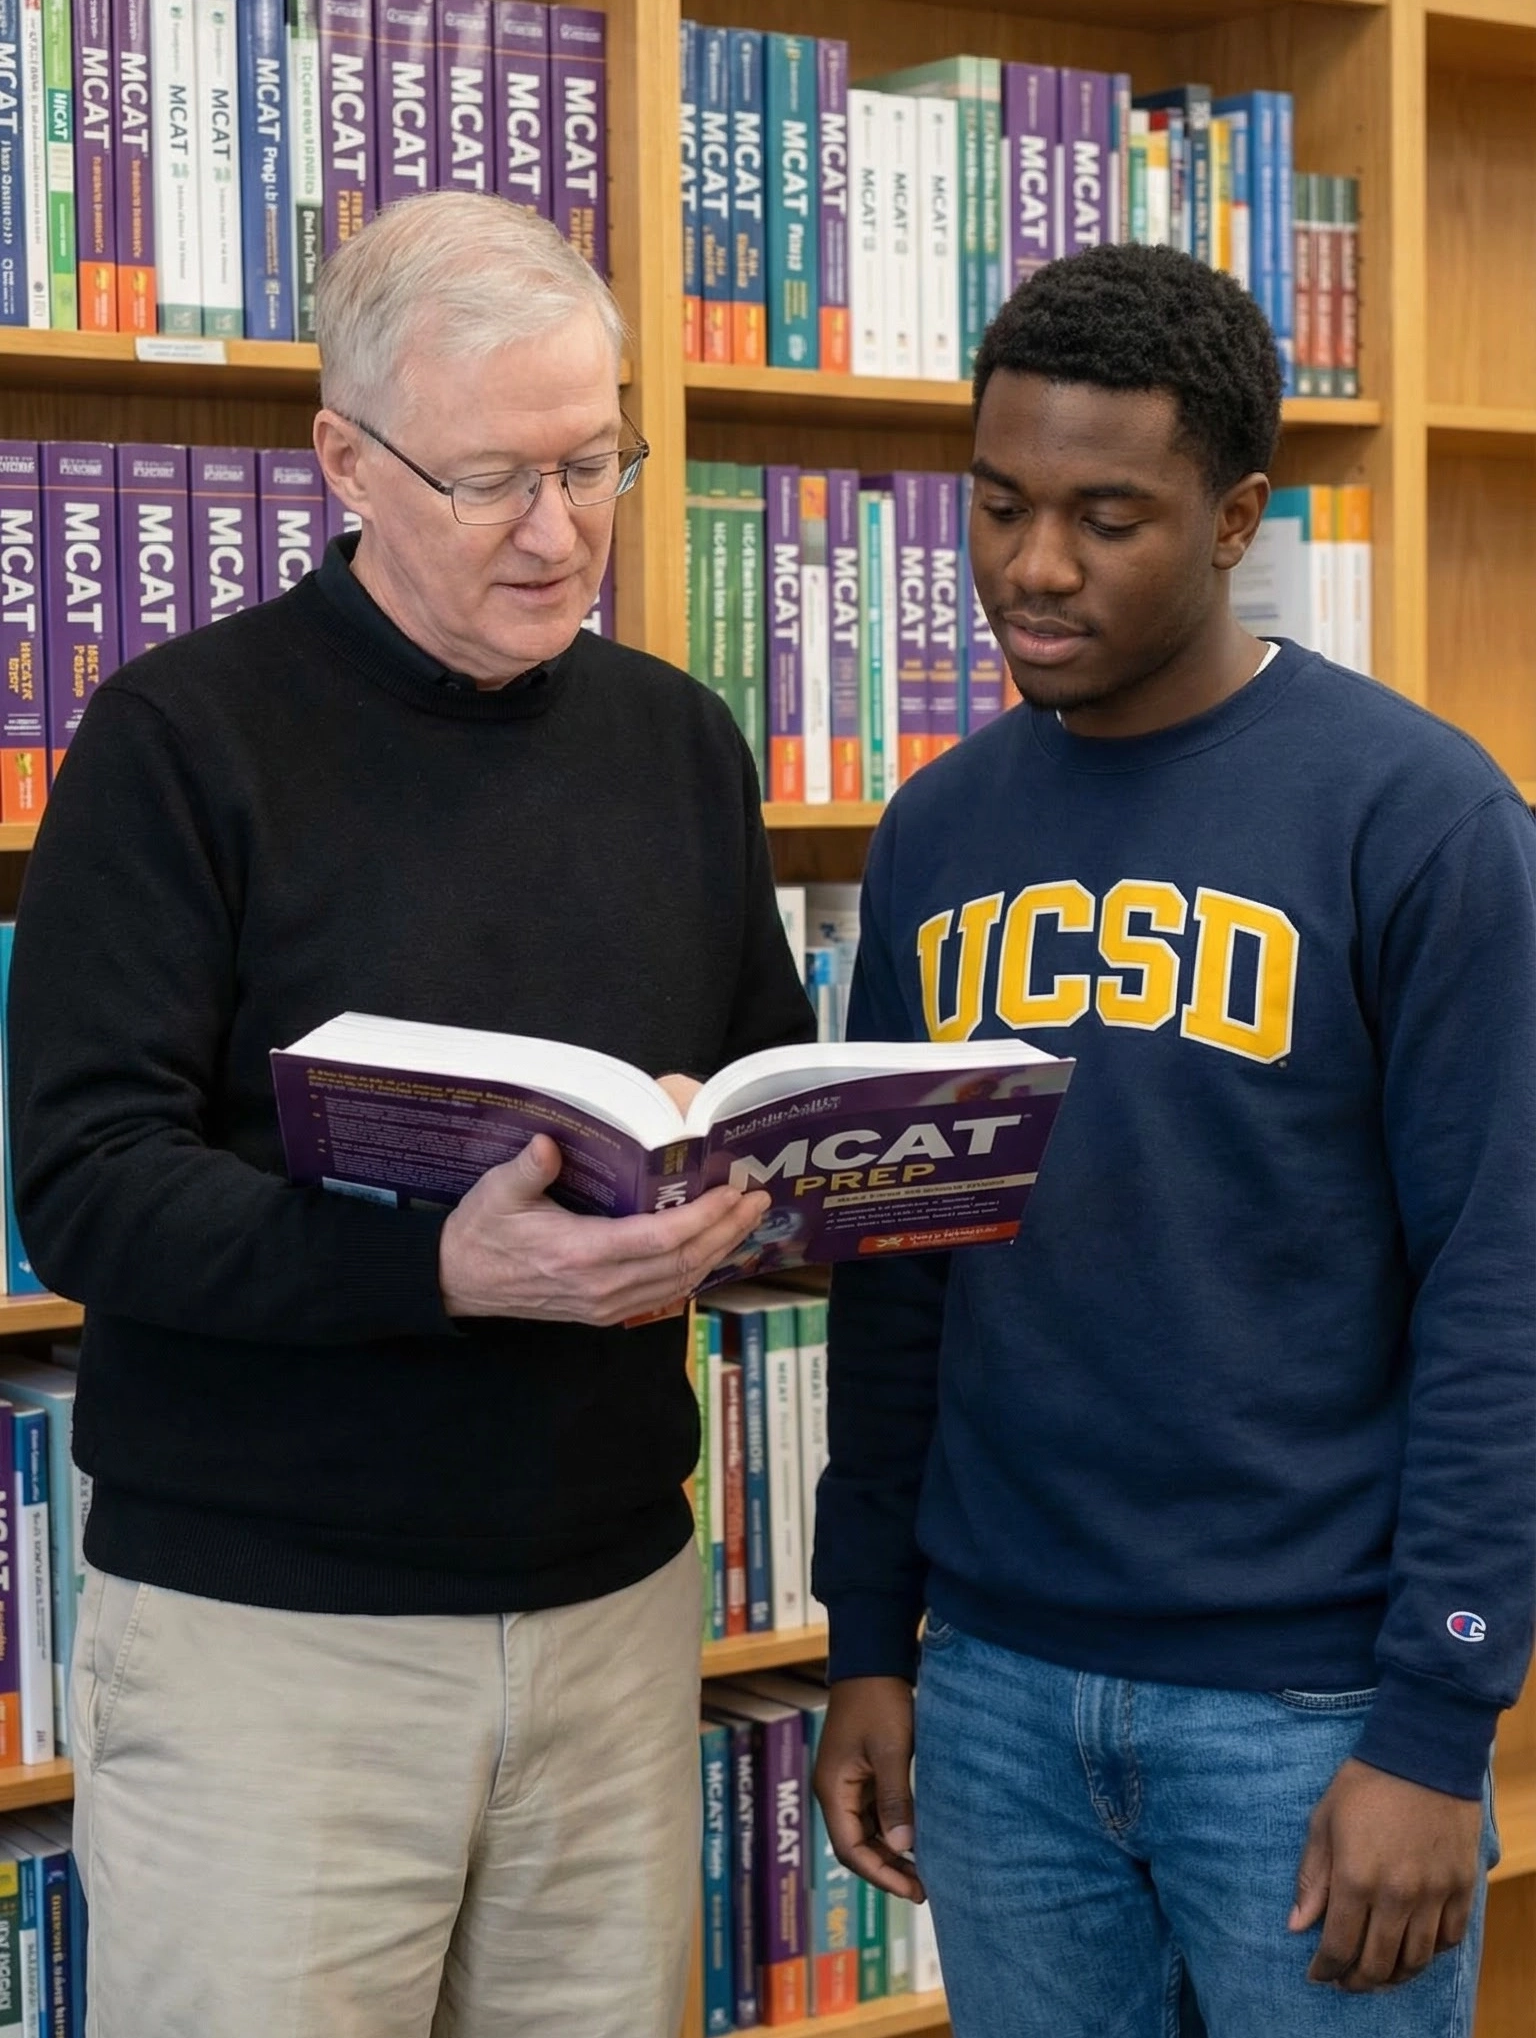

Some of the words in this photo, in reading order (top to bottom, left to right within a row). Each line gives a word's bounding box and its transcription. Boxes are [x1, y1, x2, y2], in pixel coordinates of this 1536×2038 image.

[82, 47, 110, 150] MCAT
[121, 51, 149, 153] MCAT
[169, 85, 188, 155] MCAT
[212, 88, 231, 160] MCAT
[256, 57, 281, 142] MCAT
[331, 53, 366, 182] MCAT
[392, 61, 427, 188] MCAT
[450, 66, 485, 190] MCAT
[507, 71, 541, 195] MCAT
[564, 76, 598, 200] MCAT
[701, 111, 728, 220] MCAT
[734, 111, 761, 220] MCAT
[781, 119, 809, 217] MCAT
[821, 112, 847, 215] MCAT
[861, 168, 878, 232] MCAT
[893, 172, 908, 234] MCAT
[932, 175, 948, 237] MCAT
[1019, 134, 1048, 249] MCAT
[1073, 140, 1101, 248] MCAT
[0, 508, 36, 633] MCAT
[64, 502, 103, 634] MCAT
[138, 504, 176, 634] MCAT
[277, 510, 313, 592] MC
[774, 543, 800, 644] MCAT
[833, 547, 858, 650] MCAT
[900, 546, 925, 649] MCAT
[931, 549, 957, 651] MCAT
[917, 878, 1300, 1064] UCSD
[655, 1180, 688, 1211] MC
[728, 1114, 1022, 1192] MCAT
[794, 1163, 936, 1196] PREP
[706, 1760, 724, 1831] MCAT
[738, 1754, 753, 1825] MCAT
[777, 1779, 800, 1867] MCAT
